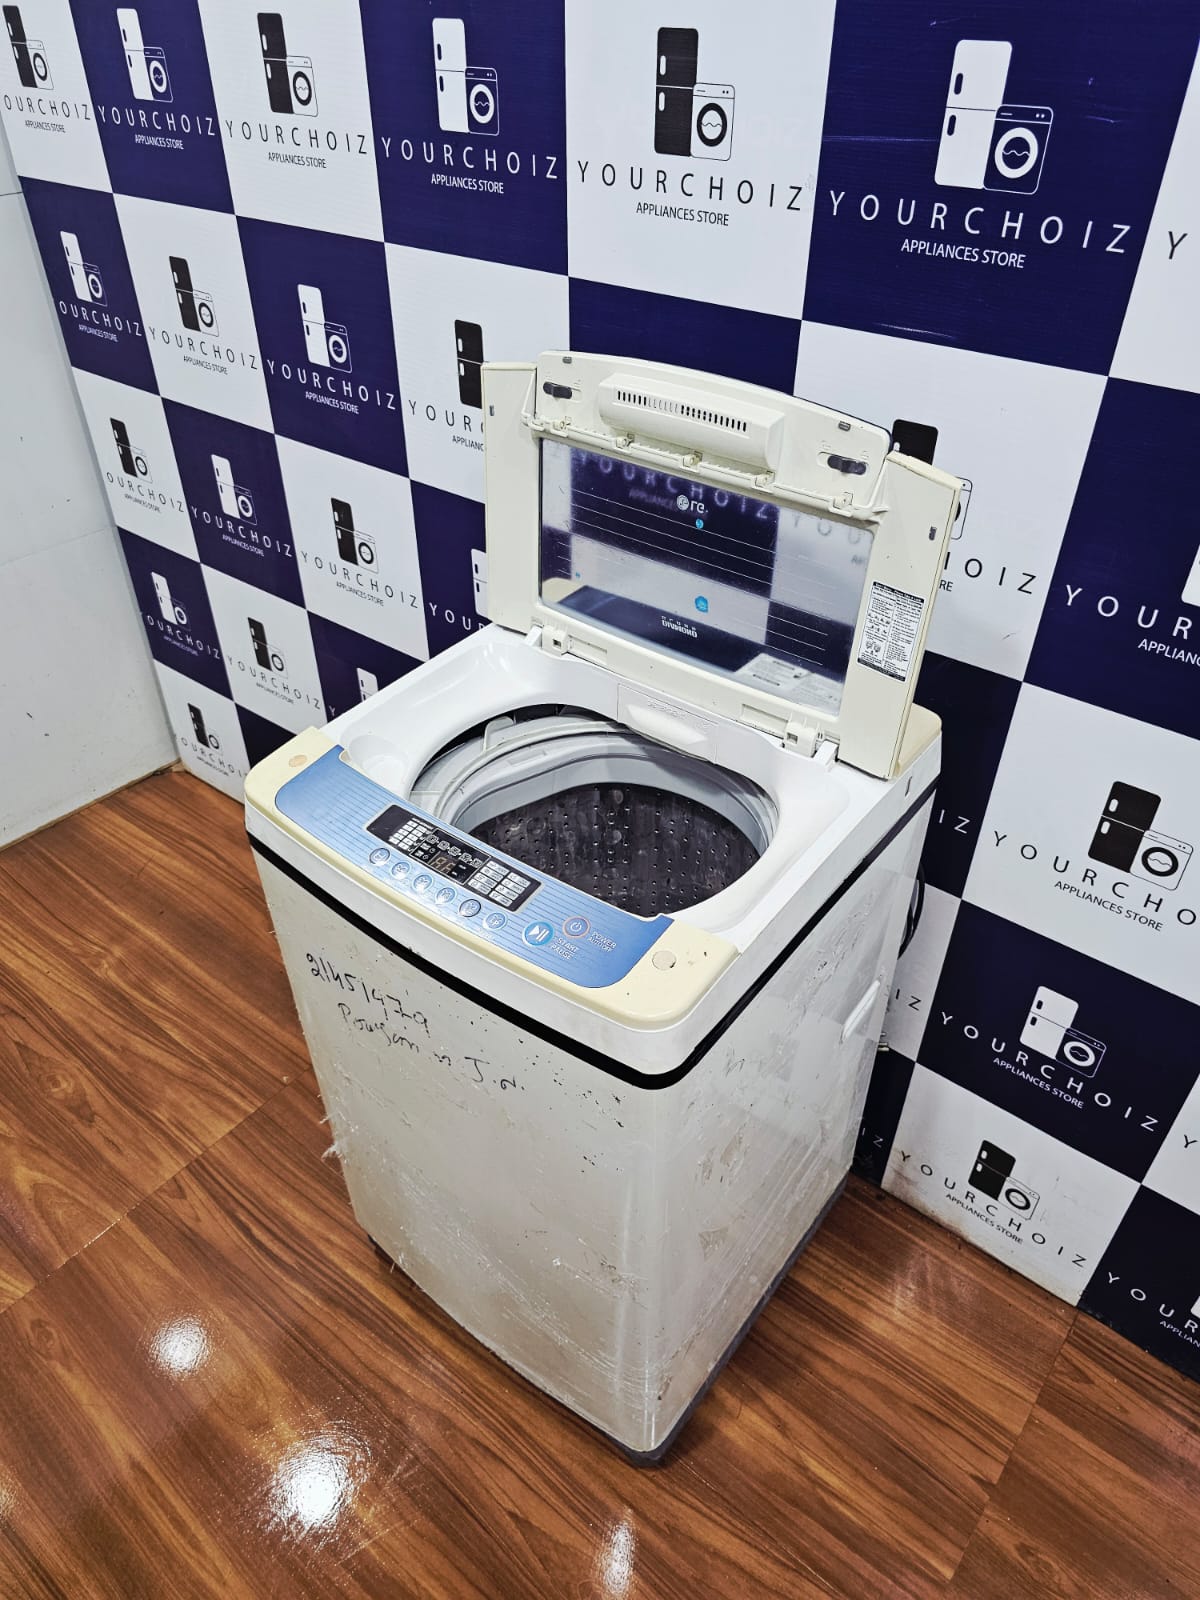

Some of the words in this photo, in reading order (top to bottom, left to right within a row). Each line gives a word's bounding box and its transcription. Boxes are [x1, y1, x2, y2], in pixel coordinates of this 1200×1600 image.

[4, 94, 91, 121] OURCHOIZ
[98, 105, 215, 136] YOURCHOIZ
[135, 134, 166, 148] APPLIANCES
[166, 138, 184, 150] STORE
[225, 120, 367, 155] YOURCHOIZ
[381, 136, 558, 180] YOURCHOIZ
[268, 152, 305, 166] APPLIANCES
[306, 157, 327, 169] STORE
[431, 173, 477, 190] APPLIANCES
[478, 180, 504, 194] STORE
[577, 160, 803, 211] YOURCHOIZ
[636, 202, 695, 221] APPLIANCES
[697, 210, 730, 226] STORE
[829, 190, 1131, 254] YOURCHOIZ
[900, 238, 979, 262] APPLIANCES
[981, 249, 1026, 269] STORE
[59, 300, 142, 336] OURCHOIZ
[148, 326, 258, 370] YOURCHOIZ
[267, 359, 396, 410] YOURCHOIZ
[305, 391, 339, 408] APPLIANCES
[340, 401, 359, 414] STORE
[452, 435, 484, 452] APPLIANC
[106, 472, 184, 512] OURCHOIZ
[191, 505, 292, 557] YOURCHOIZ
[301, 551, 418, 608] YOURCHOIZ
[147, 615, 220, 660] OURCHOIZ
[1138, 639, 1200, 668] APPLIAN
[228, 656, 320, 709] YOURCHOIZ
[994, 830, 1197, 926] YOURCHO
[1054, 880, 1123, 915] APPLIANCES
[1124, 909, 1163, 932] STORE
[551, 944, 572, 960] PAUSE
[941, 1011, 1159, 1132] YOURCHOIZ
[993, 1057, 1051, 1092] APPLIANCES
[1052, 1087, 1084, 1109] STORE
[900, 1150, 1087, 1268] YOURCHOIZ
[945, 1193, 996, 1227] APPLIANCES
[996, 1224, 1024, 1245] STORE
[1160, 1320, 1200, 1348] APPLIAN
